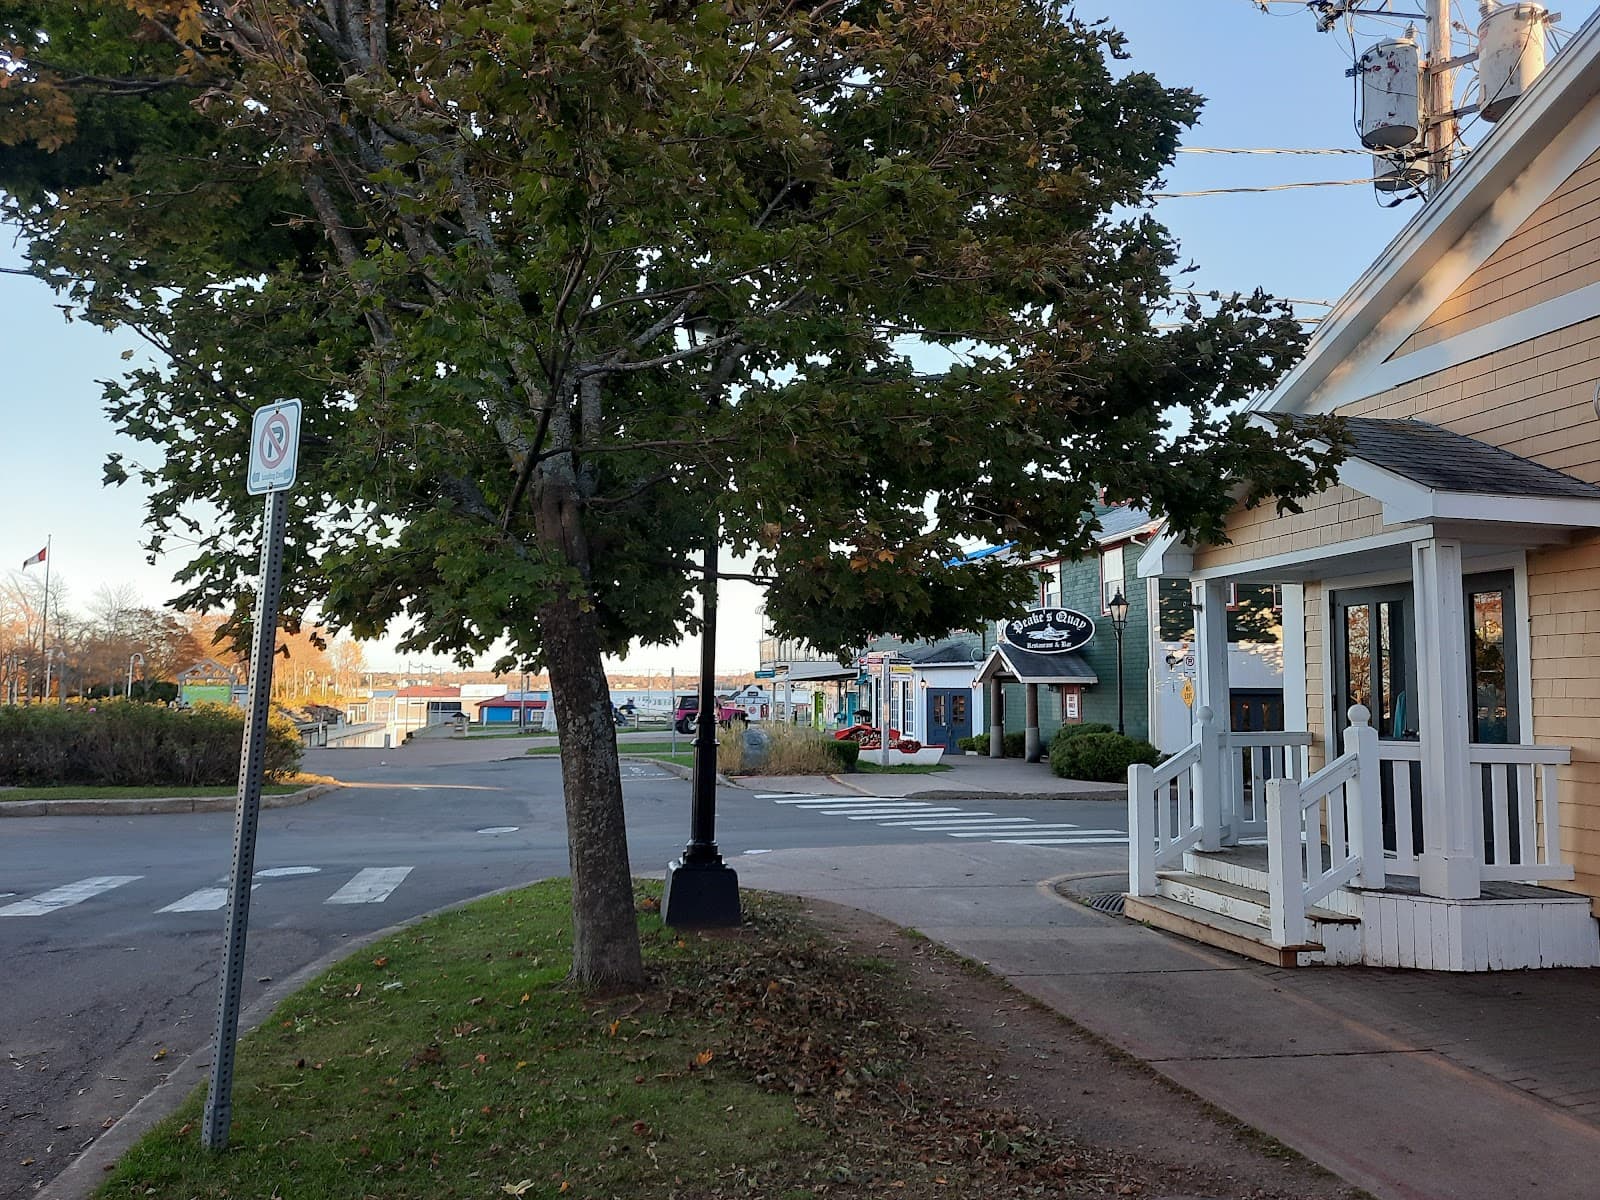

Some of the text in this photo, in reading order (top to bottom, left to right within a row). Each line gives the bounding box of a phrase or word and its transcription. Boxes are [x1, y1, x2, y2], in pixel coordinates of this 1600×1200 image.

[1011, 609, 1087, 634] Peake's Quay
[1061, 640, 1072, 648] Bar
